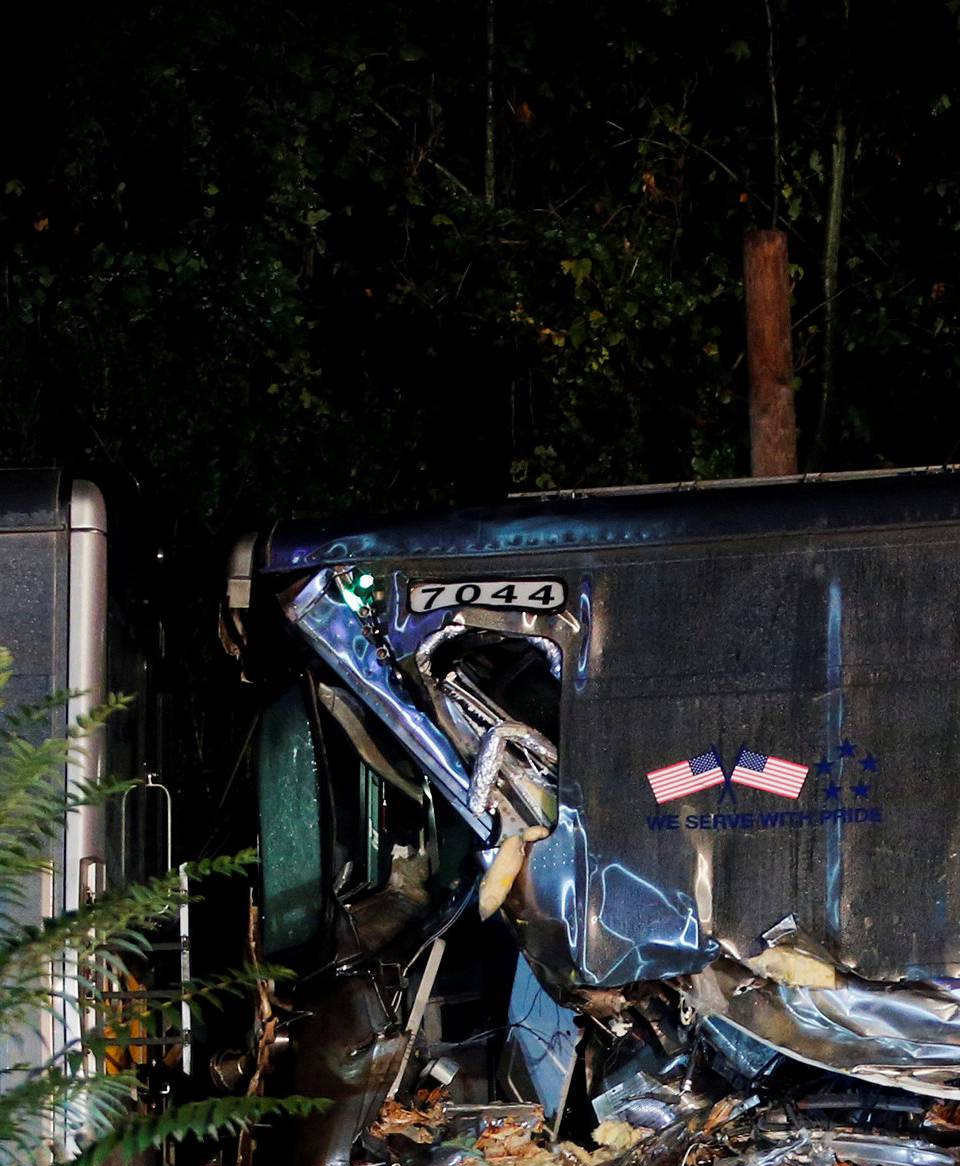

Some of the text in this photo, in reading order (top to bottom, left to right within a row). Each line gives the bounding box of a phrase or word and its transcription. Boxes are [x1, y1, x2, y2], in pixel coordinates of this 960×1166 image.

[421, 584, 555, 610] 7044
[646, 807, 882, 831] WE SERVE WITH PRIDE
